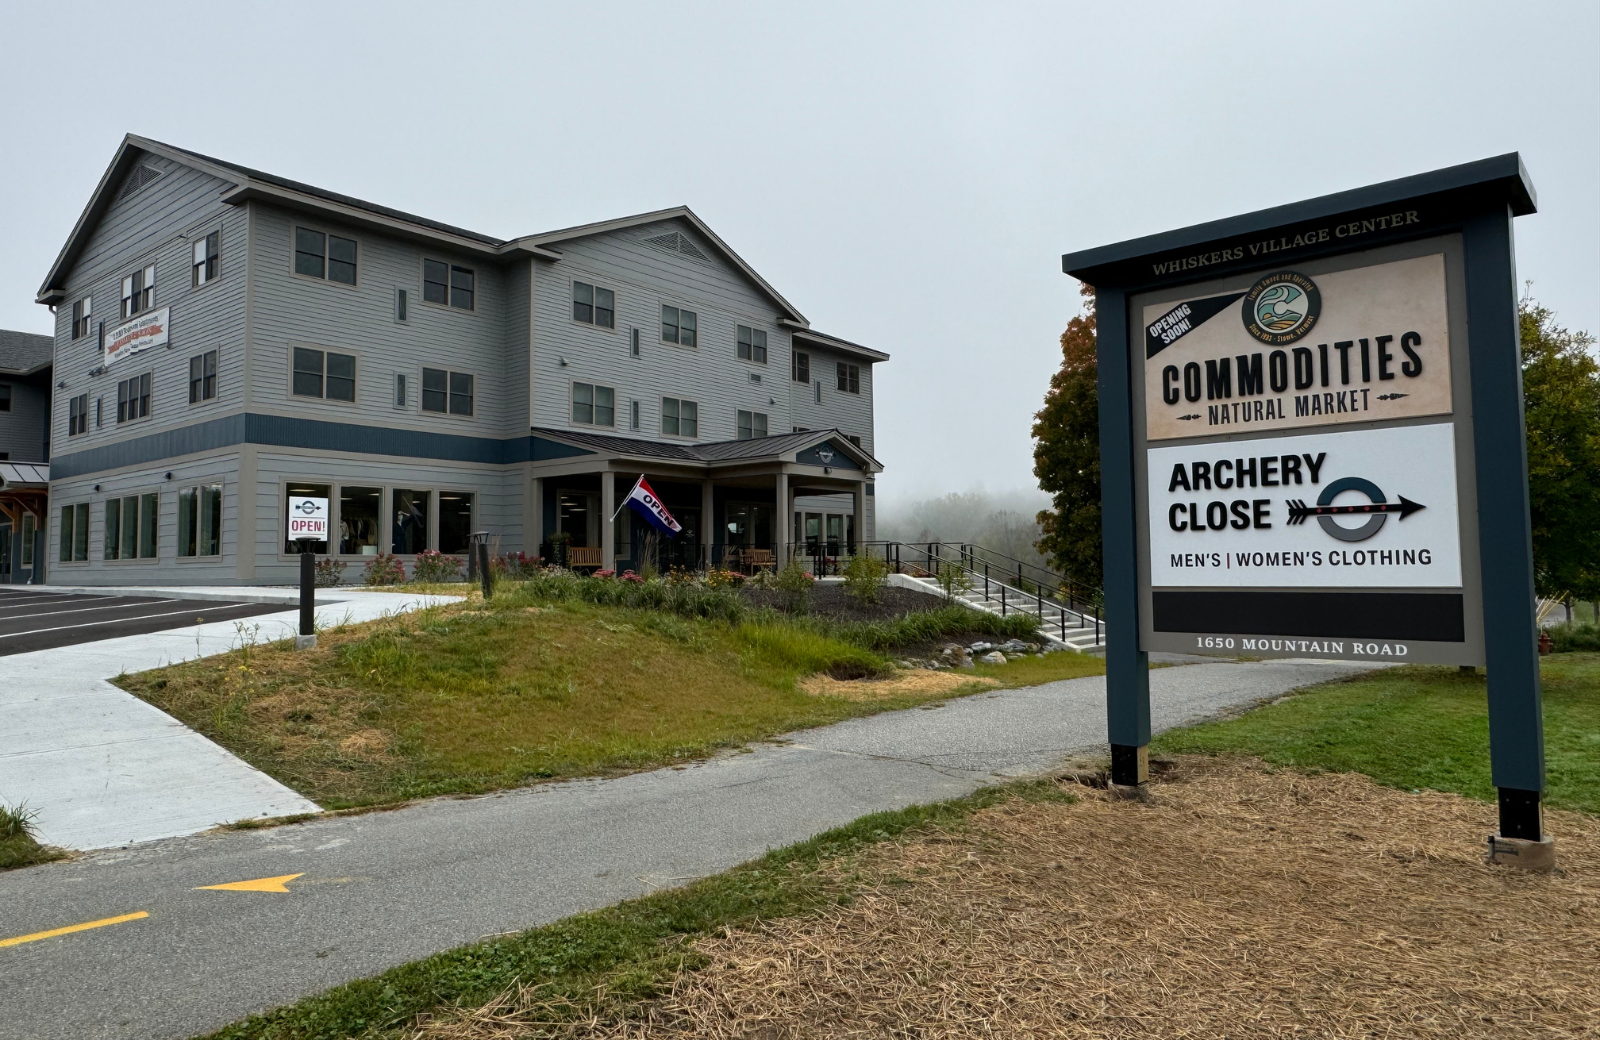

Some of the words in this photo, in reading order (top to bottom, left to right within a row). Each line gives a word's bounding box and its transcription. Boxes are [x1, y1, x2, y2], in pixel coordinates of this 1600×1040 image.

[1152, 246, 1244, 276] WHISKERS
[1248, 228, 1330, 256] VILLAGE
[1334, 210, 1421, 239] CENTER
[1281, 273, 1291, 281] and
[1148, 303, 1192, 338] OPENING
[1160, 317, 1192, 345] SOON!
[1162, 330, 1423, 405] COMMODITIES
[1208, 397, 1286, 426] NATURAL
[1295, 388, 1371, 418] MARKET
[1168, 452, 1327, 493] ARCHERY
[291, 520, 326, 532] OPEN!
[643, 494, 675, 527] OPEN
[1168, 499, 1272, 532] CLOSE
[1170, 553, 1222, 568] MEN'S
[1236, 550, 1323, 567] WOMEN'S
[1328, 549, 1433, 566] CLOTHING
[1196, 636, 1235, 649] 1650
[1242, 639, 1345, 654] MOUNTAIN
[1352, 642, 1409, 657] ROAD
